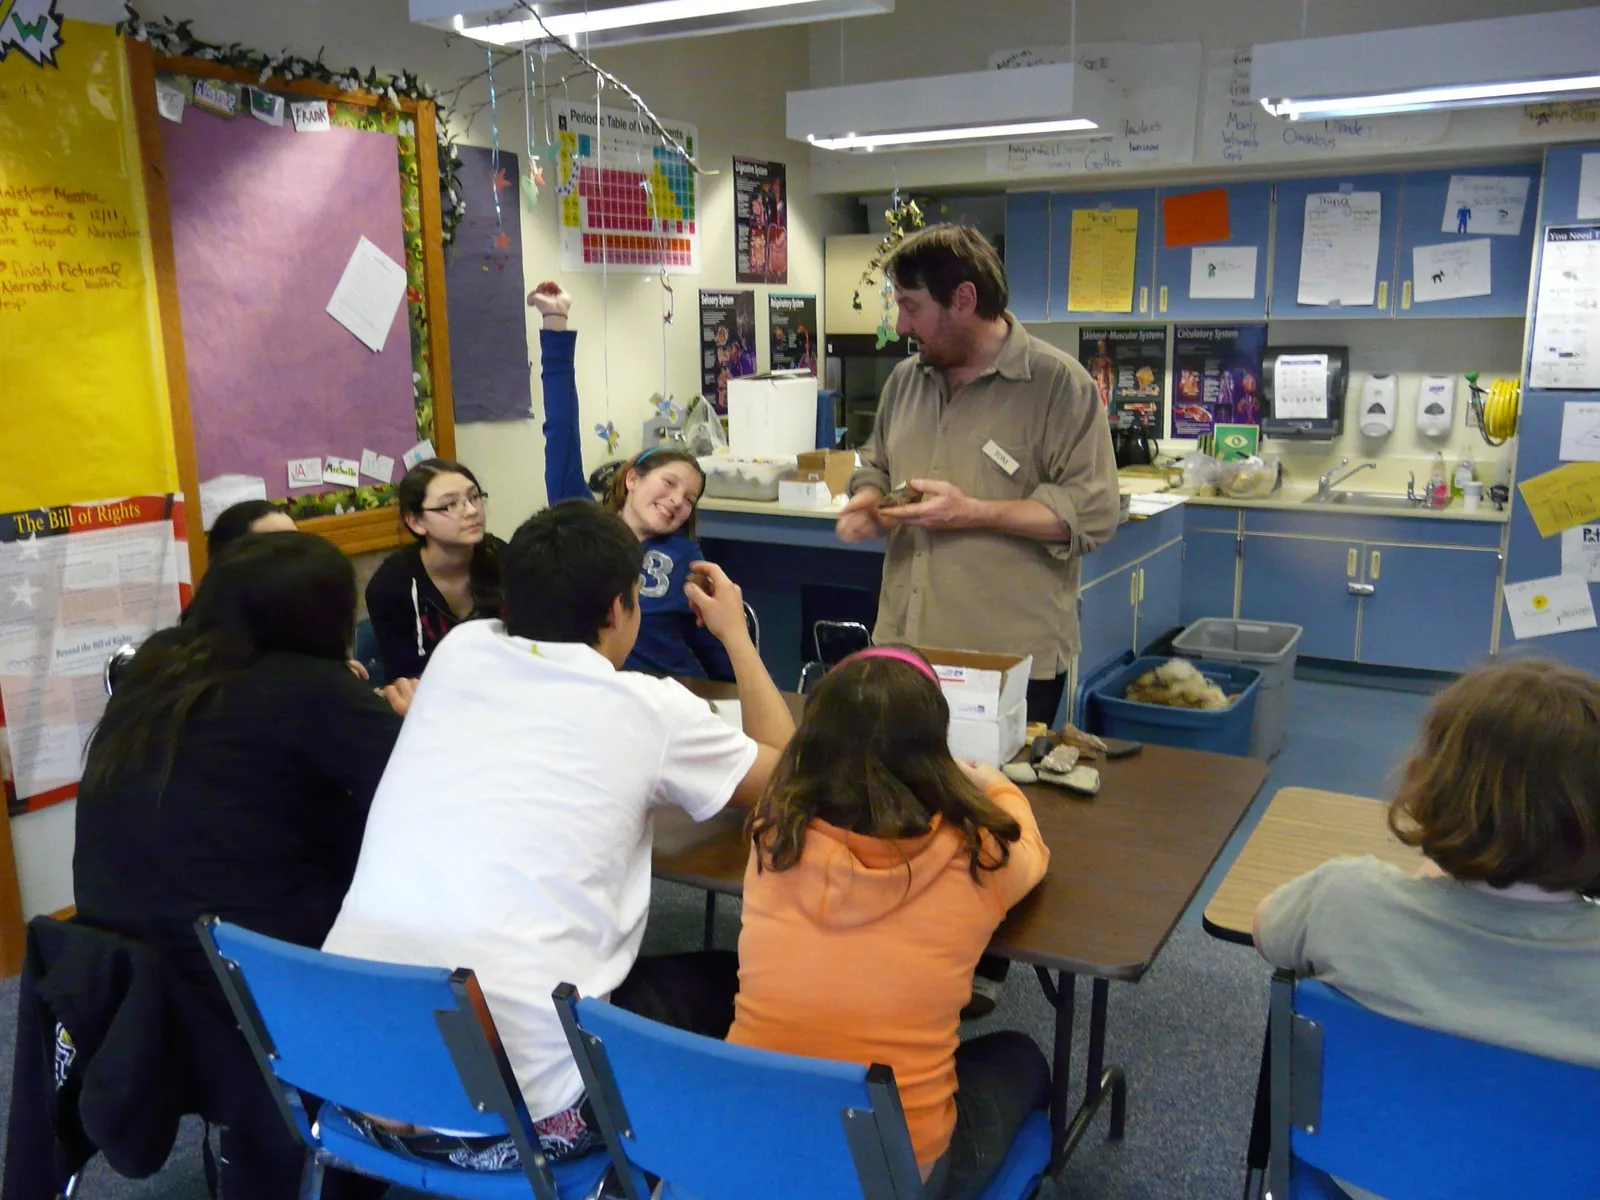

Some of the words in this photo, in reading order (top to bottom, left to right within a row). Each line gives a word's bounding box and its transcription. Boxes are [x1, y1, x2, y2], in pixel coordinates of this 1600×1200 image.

[295, 107, 328, 124] FRANK
[570, 108, 605, 127] Periodc
[607, 115, 628, 130] Table
[628, 120, 637, 132] of
[754, 163, 768, 177] System
[1550, 232, 1567, 240] You
[1570, 231, 1592, 240] Need
[2, 279, 76, 294] Narrative
[718, 293, 734, 308] System
[791, 298, 804, 311] System
[1138, 329, 1165, 342] Systems
[1177, 328, 1214, 341] Circulatory
[1215, 329, 1239, 341] System
[325, 462, 357, 478] Michelle
[13, 512, 45, 534] The
[48, 505, 74, 530] Bill
[78, 509, 94, 525] of
[97, 502, 141, 526] Rights
[56, 646, 81, 659] Beyond
[81, 642, 91, 654] the
[92, 639, 104, 651] Bill
[105, 639, 111, 647] of
[113, 634, 132, 648] Rights
